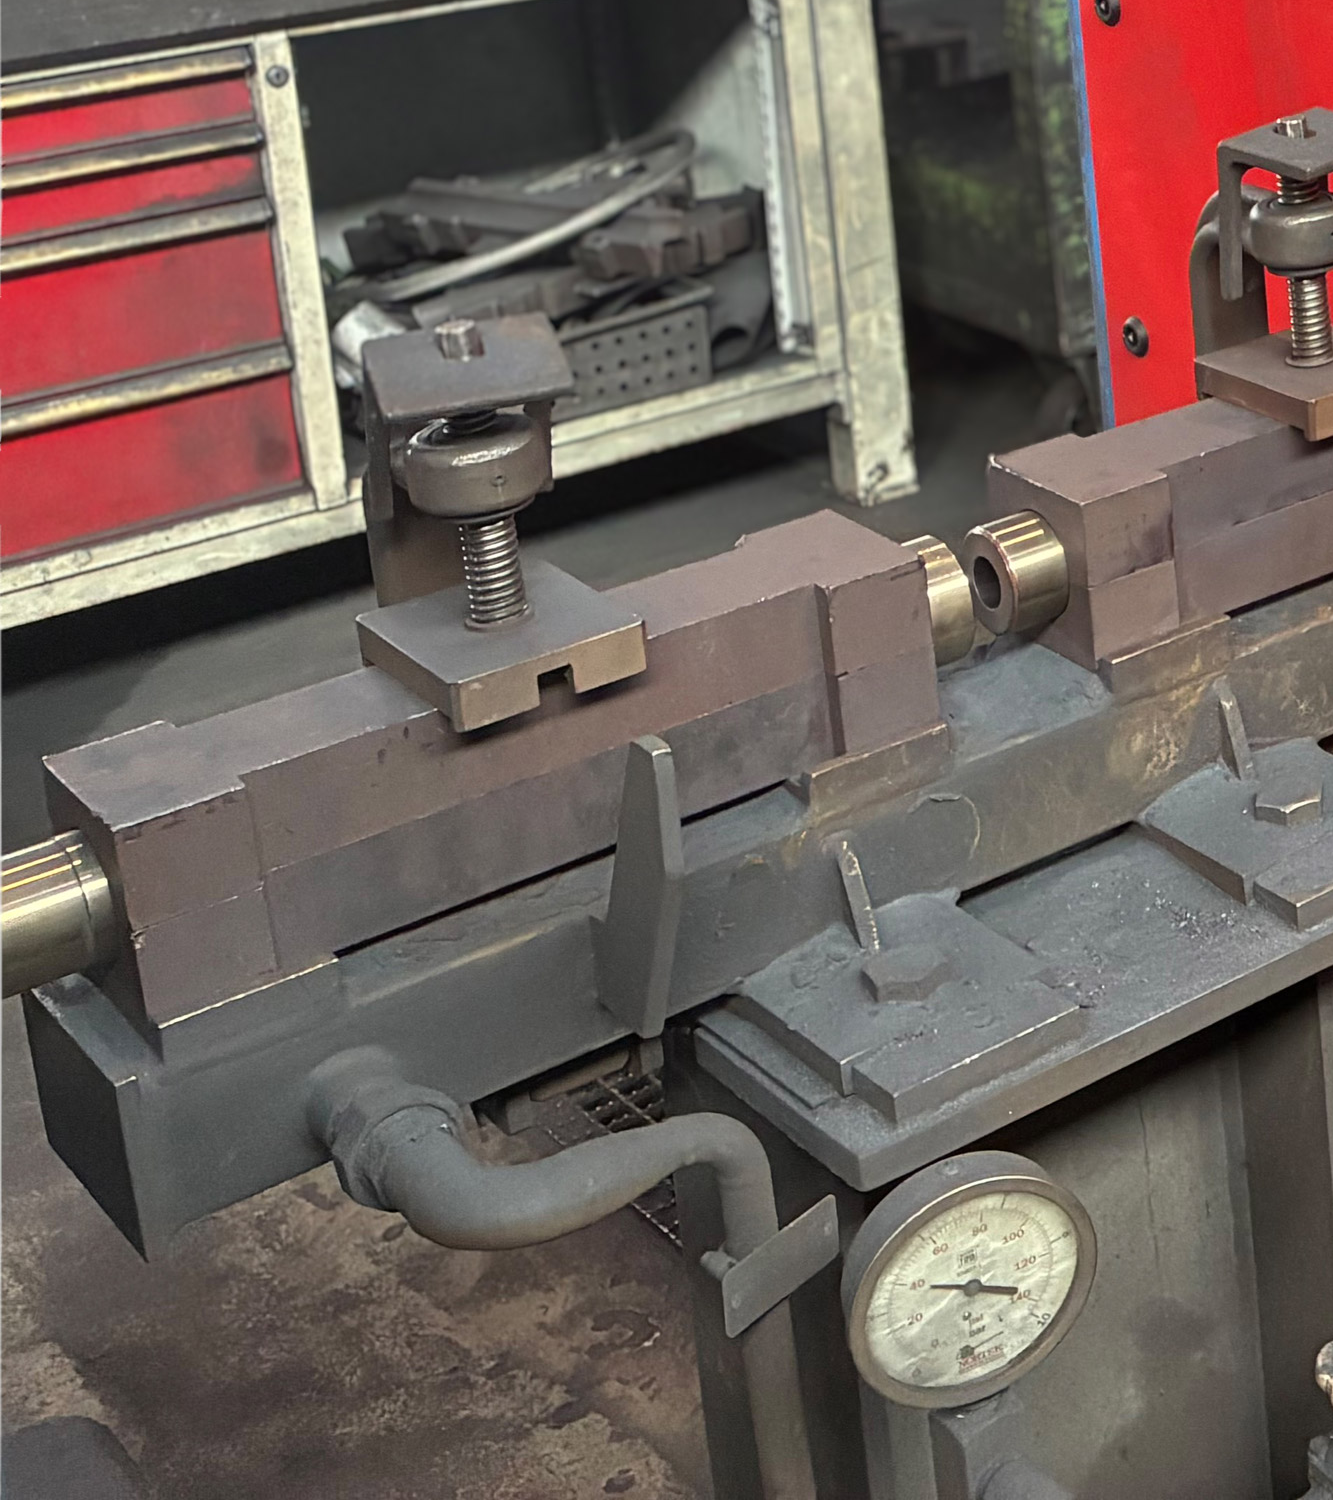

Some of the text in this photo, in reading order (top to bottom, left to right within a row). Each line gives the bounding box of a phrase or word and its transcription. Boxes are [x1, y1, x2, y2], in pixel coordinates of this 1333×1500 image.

[971, 1223, 988, 1238] 80
[1002, 1228, 1025, 1245] 100
[932, 1242, 949, 1256] 60
[1014, 1255, 1036, 1271] 120
[909, 1278, 925, 1292] 40
[907, 1312, 923, 1326] 20
[1036, 1312, 1051, 1327] 10
